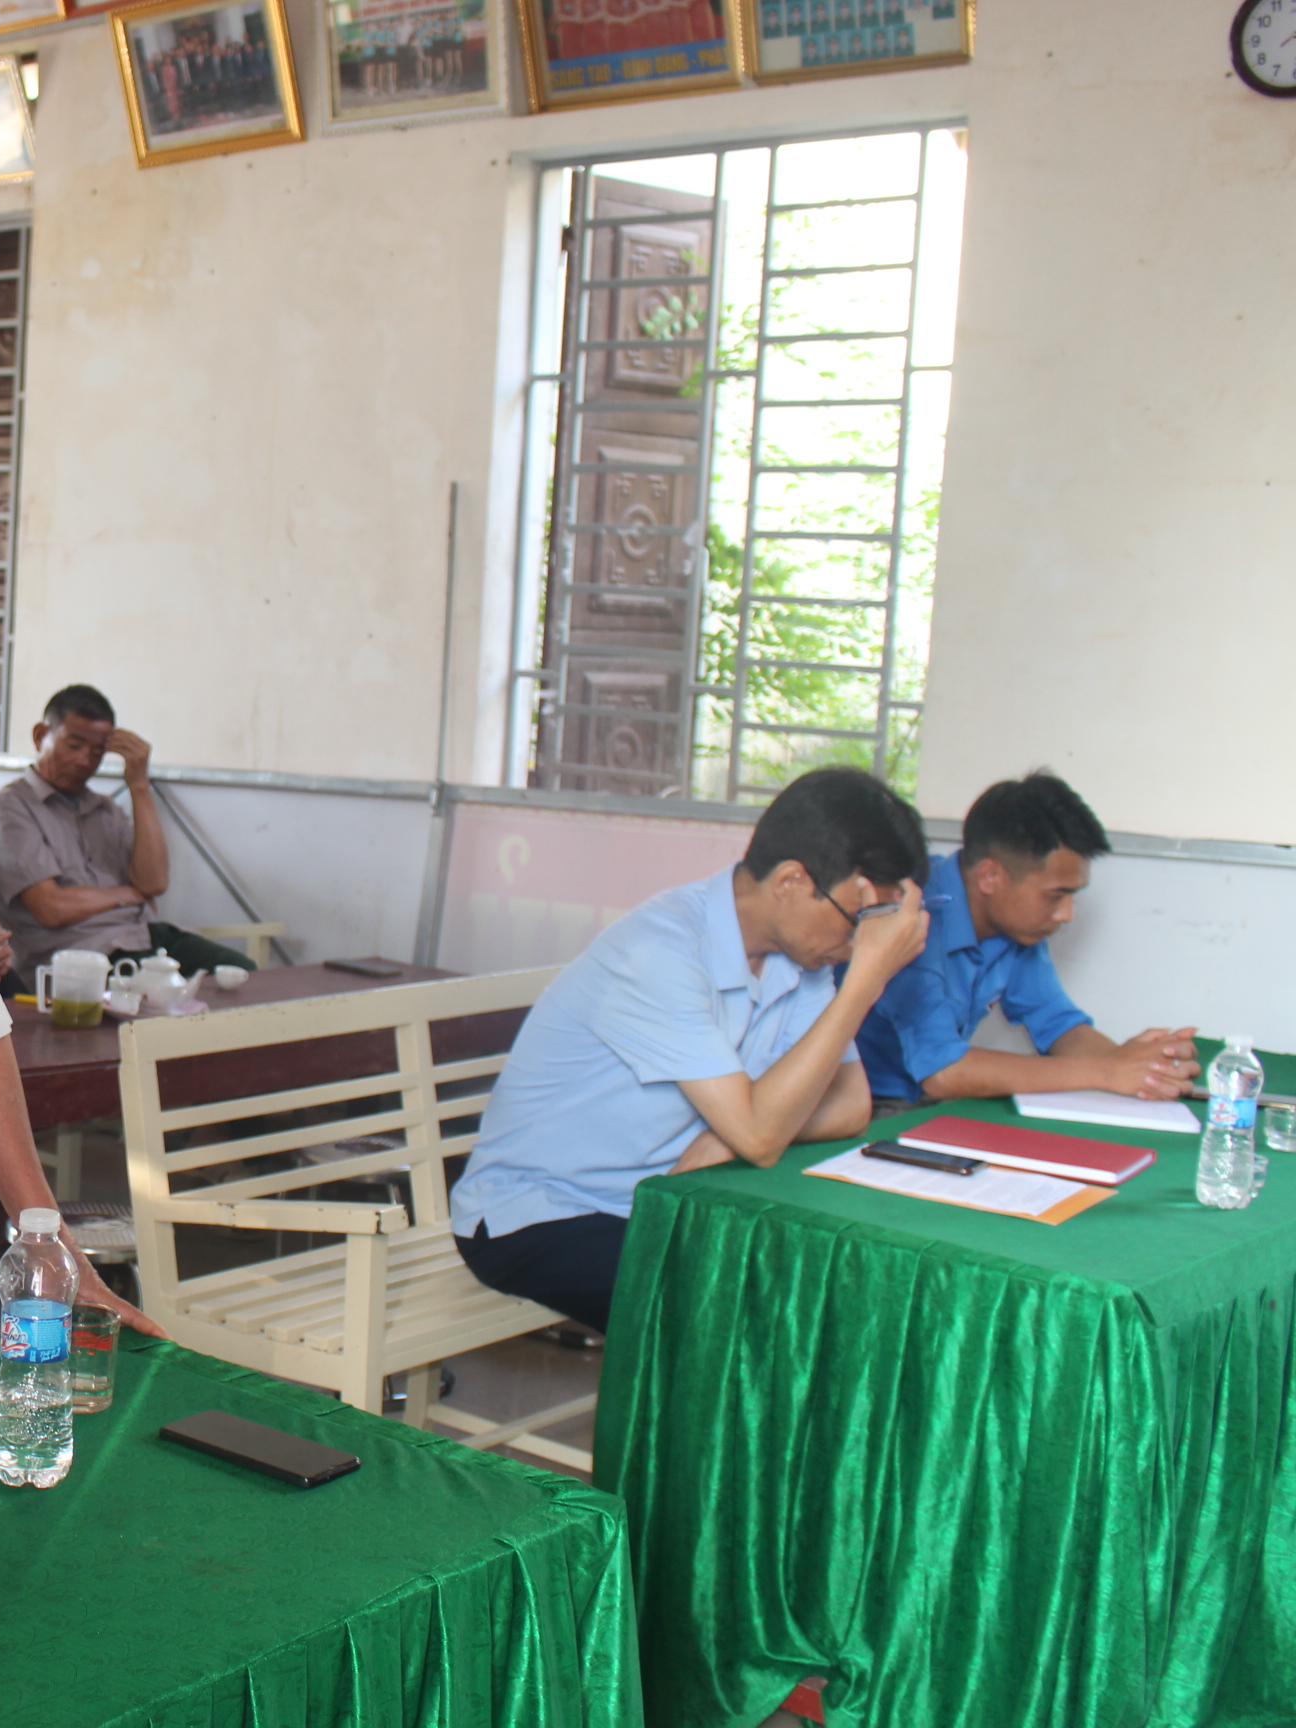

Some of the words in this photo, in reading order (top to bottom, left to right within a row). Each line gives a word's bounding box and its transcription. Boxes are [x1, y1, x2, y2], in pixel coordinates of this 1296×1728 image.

[1271, 0, 1282, 12] 11
[1258, 15, 1271, 28] 10
[1251, 34, 1261, 48] 9
[1257, 52, 1266, 65] 8
[1272, 64, 1281, 77] 7
